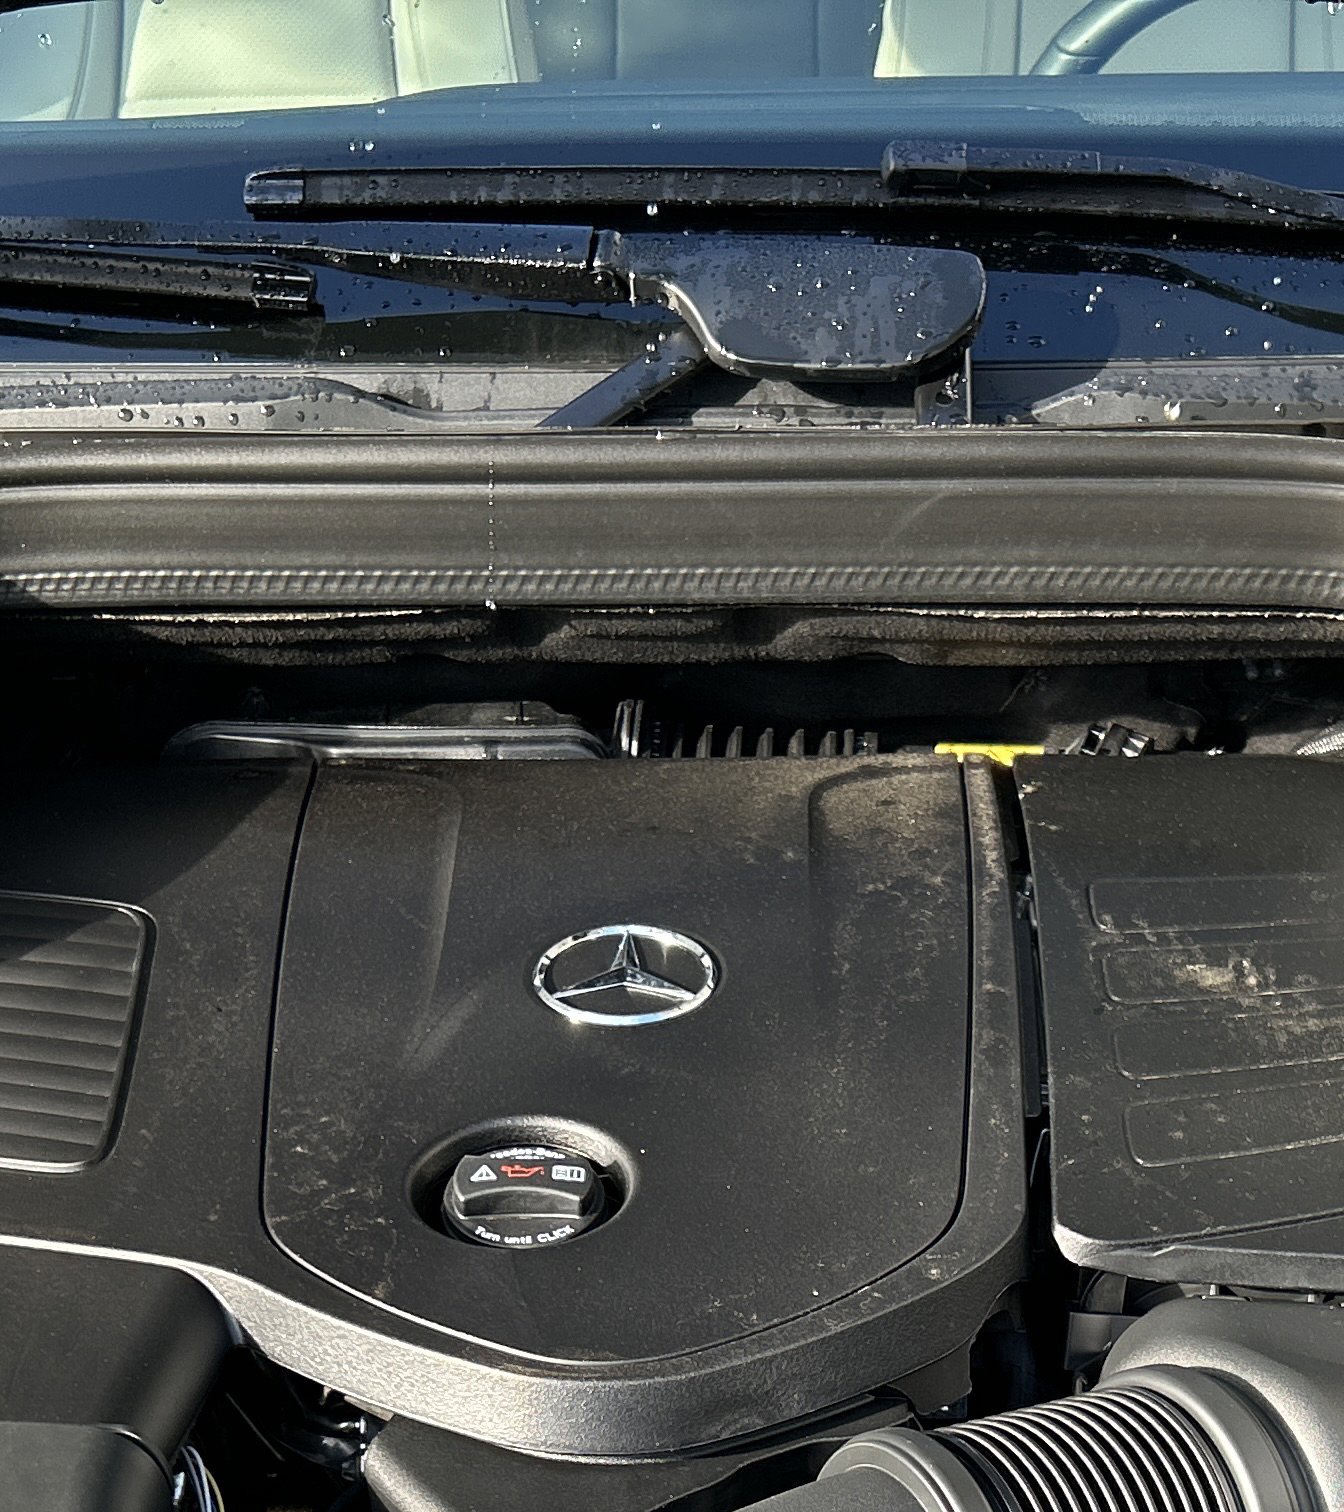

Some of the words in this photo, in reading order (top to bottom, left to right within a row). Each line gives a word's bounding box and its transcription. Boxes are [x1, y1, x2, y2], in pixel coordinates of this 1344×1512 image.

[475, 1225, 501, 1242] Turn
[504, 1235, 532, 1244] until
[537, 1224, 575, 1243] CLICK
